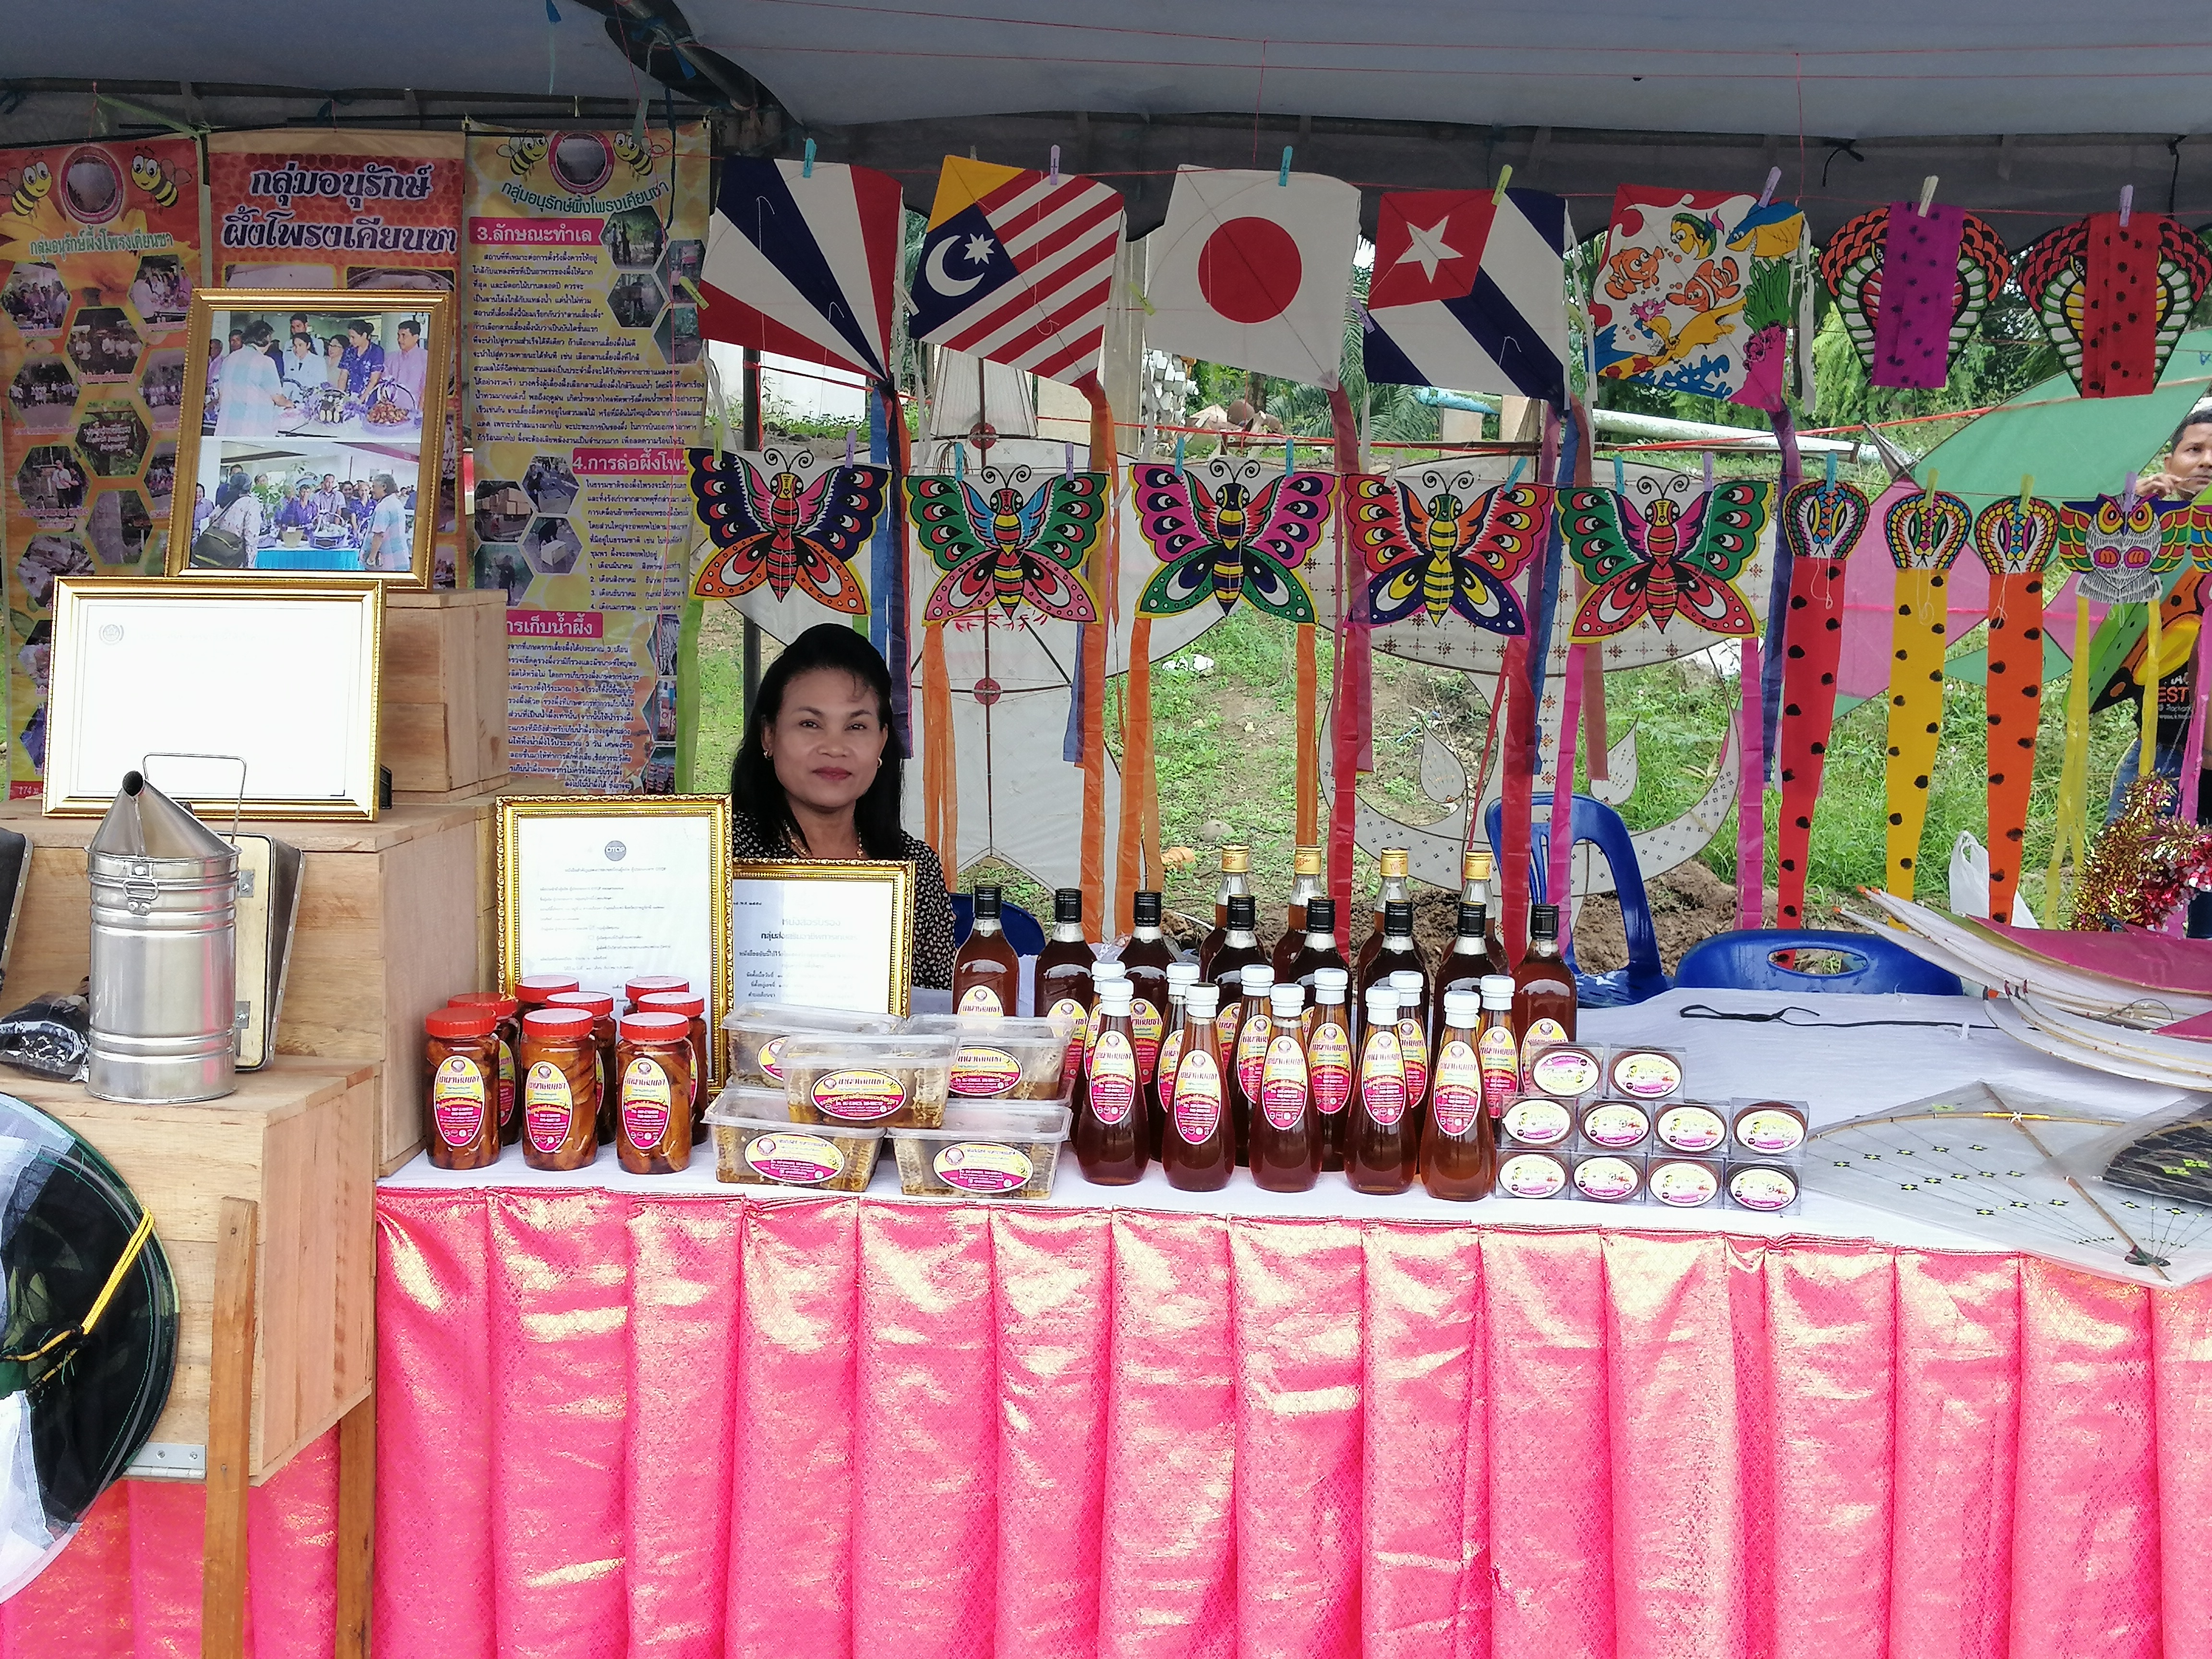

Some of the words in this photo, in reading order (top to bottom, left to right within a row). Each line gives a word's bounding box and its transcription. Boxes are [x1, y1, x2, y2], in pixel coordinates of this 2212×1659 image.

[251, 162, 432, 209] กลุ่มอนุรักษ์
[501, 180, 670, 215] กลุ่มอนุรักษ์ผึ้งโพรงเคียนซา
[30, 224, 174, 263] กลุ่มอนุรักษ์ผึ้งโพรงเคียนซา
[222, 205, 457, 252] ผึ้งโพรงเคียนซา
[477, 223, 592, 242] 3.ลักษณะทำเล
